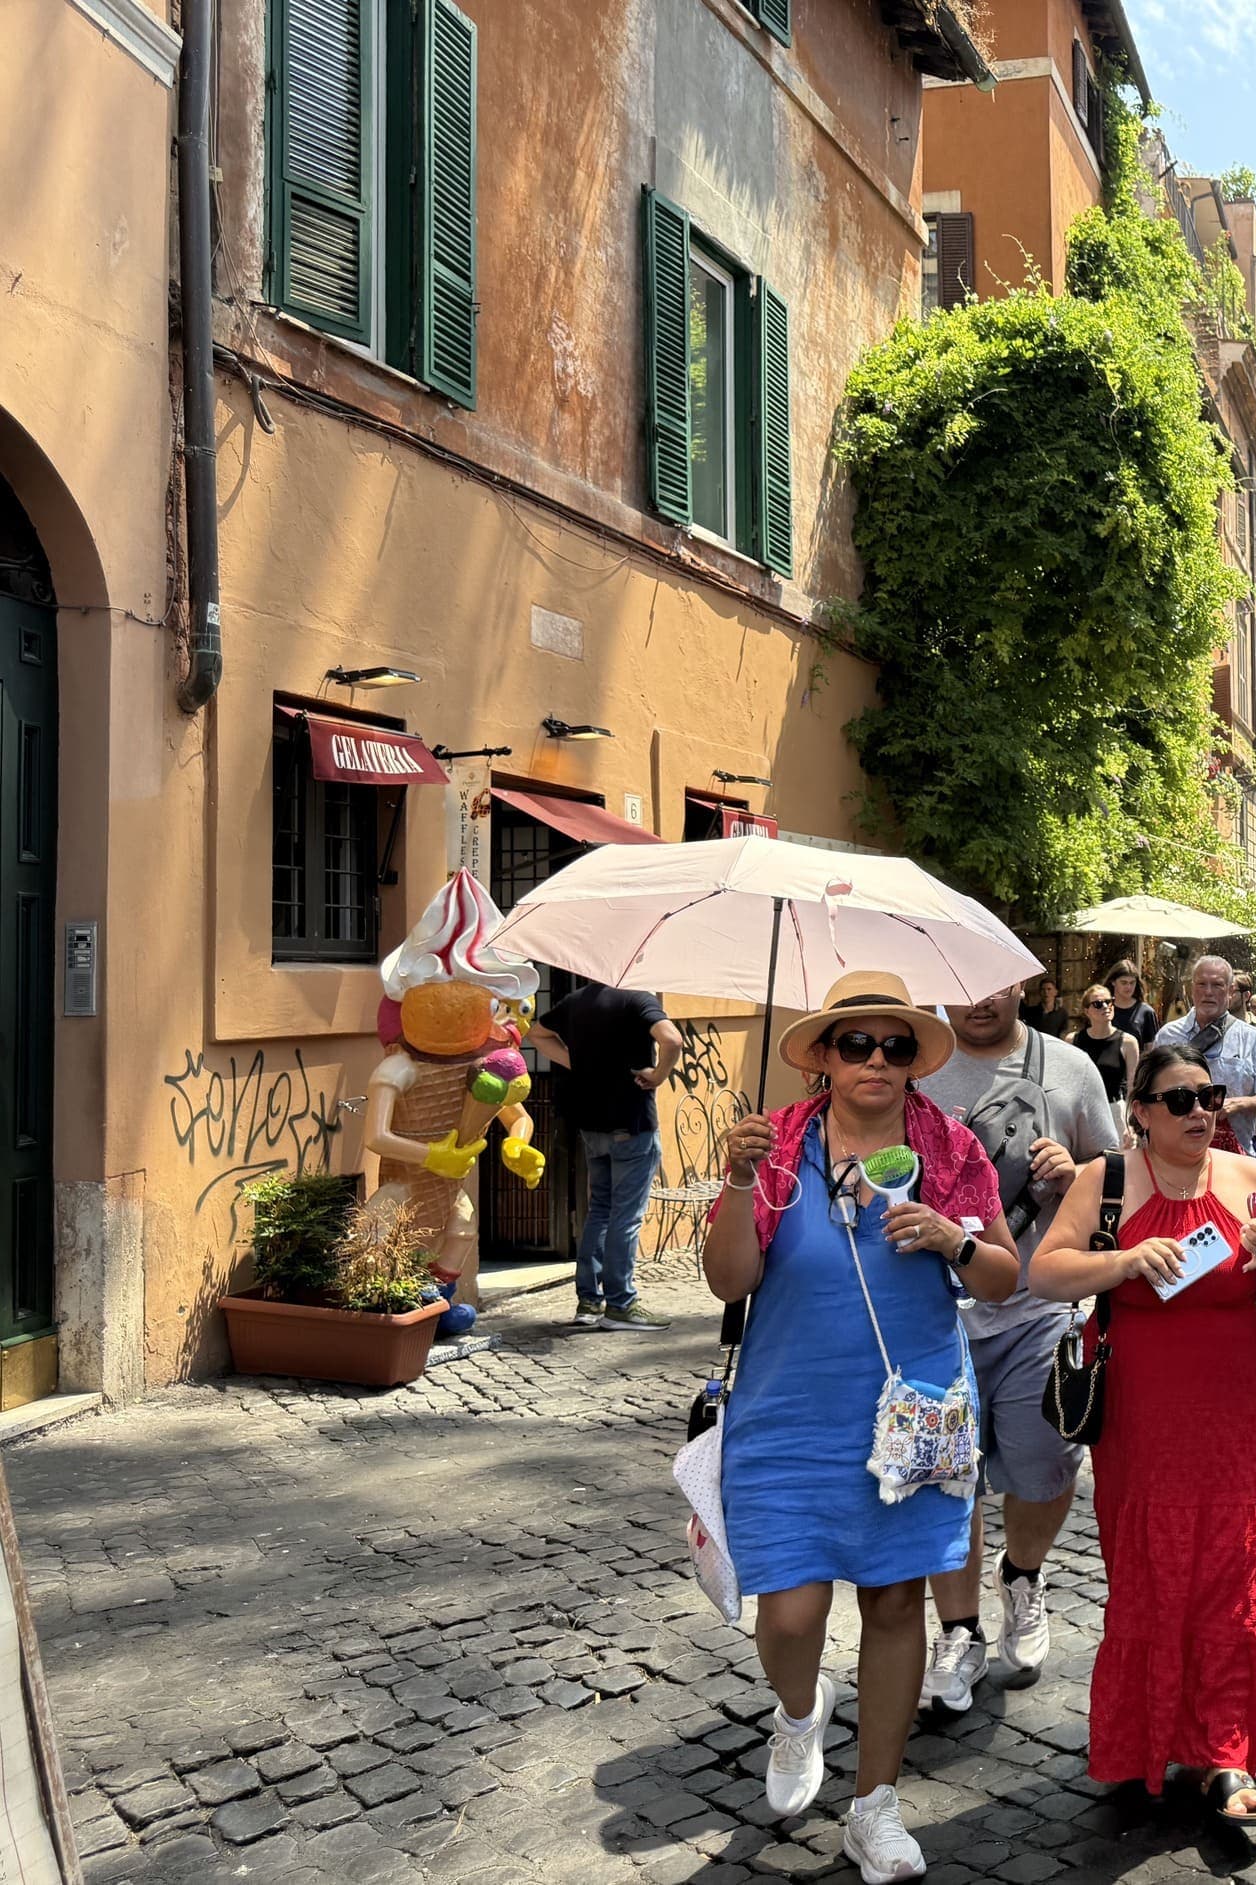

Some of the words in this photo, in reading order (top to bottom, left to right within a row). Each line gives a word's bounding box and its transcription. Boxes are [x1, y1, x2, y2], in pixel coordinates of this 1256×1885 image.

[331, 734, 424, 774] GELATERIA
[459, 789, 469, 867] WAFFLES
[630, 802, 638, 820] 6
